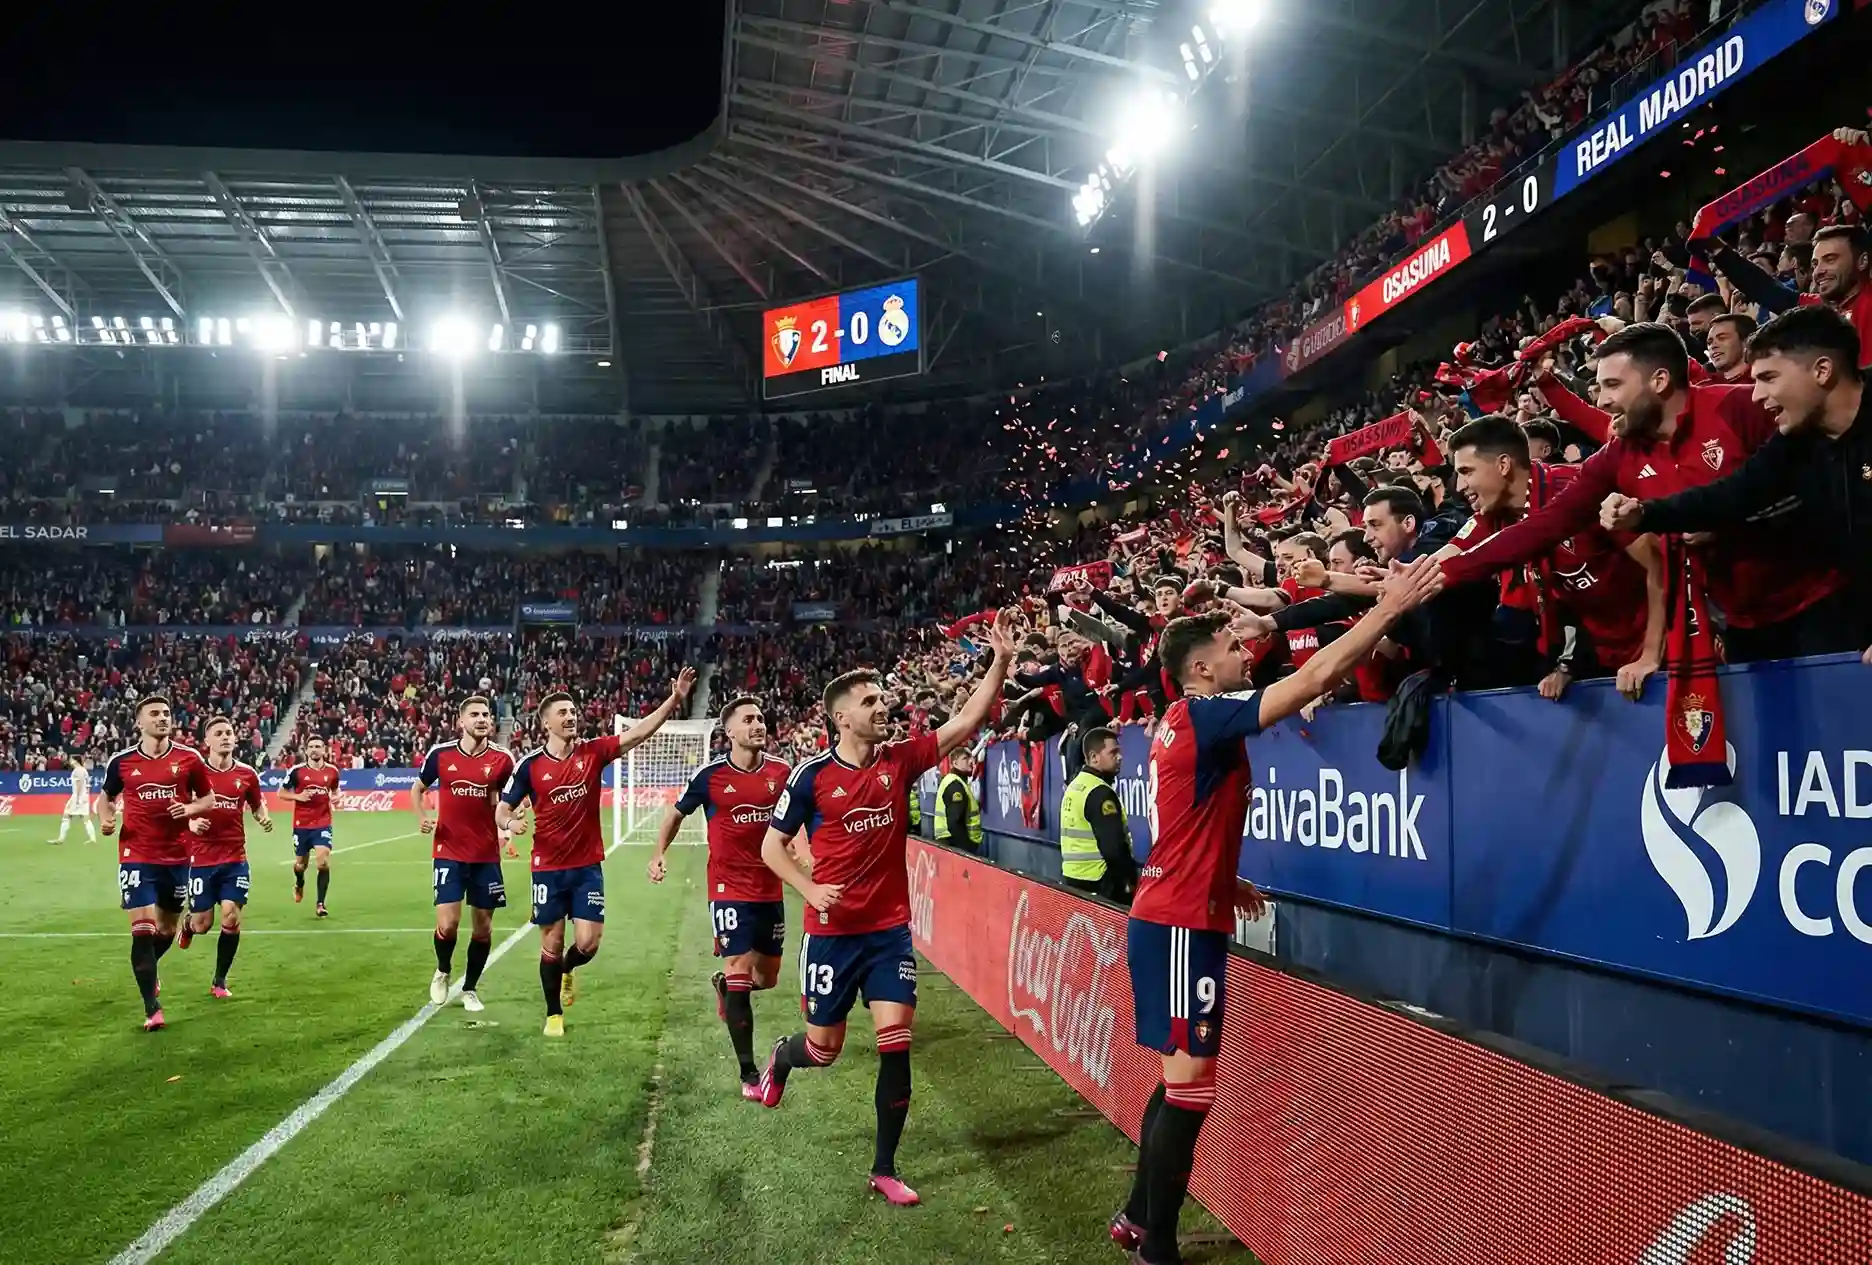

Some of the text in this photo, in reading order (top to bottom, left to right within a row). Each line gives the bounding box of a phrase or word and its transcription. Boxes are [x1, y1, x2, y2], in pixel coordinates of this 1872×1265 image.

[1577, 35, 1744, 176] REAL MADRID
[1483, 204, 1497, 242] 2
[1523, 176, 1538, 213] 0
[1383, 238, 1450, 303] OSASUNA
[821, 364, 860, 385] FINAL
[0, 526, 88, 538] EL SADAR
[844, 808, 894, 834] verital
[120, 870, 141, 889] 24
[716, 907, 738, 931] 18
[808, 963, 834, 995] 13
[1197, 977, 1215, 1014] 9
